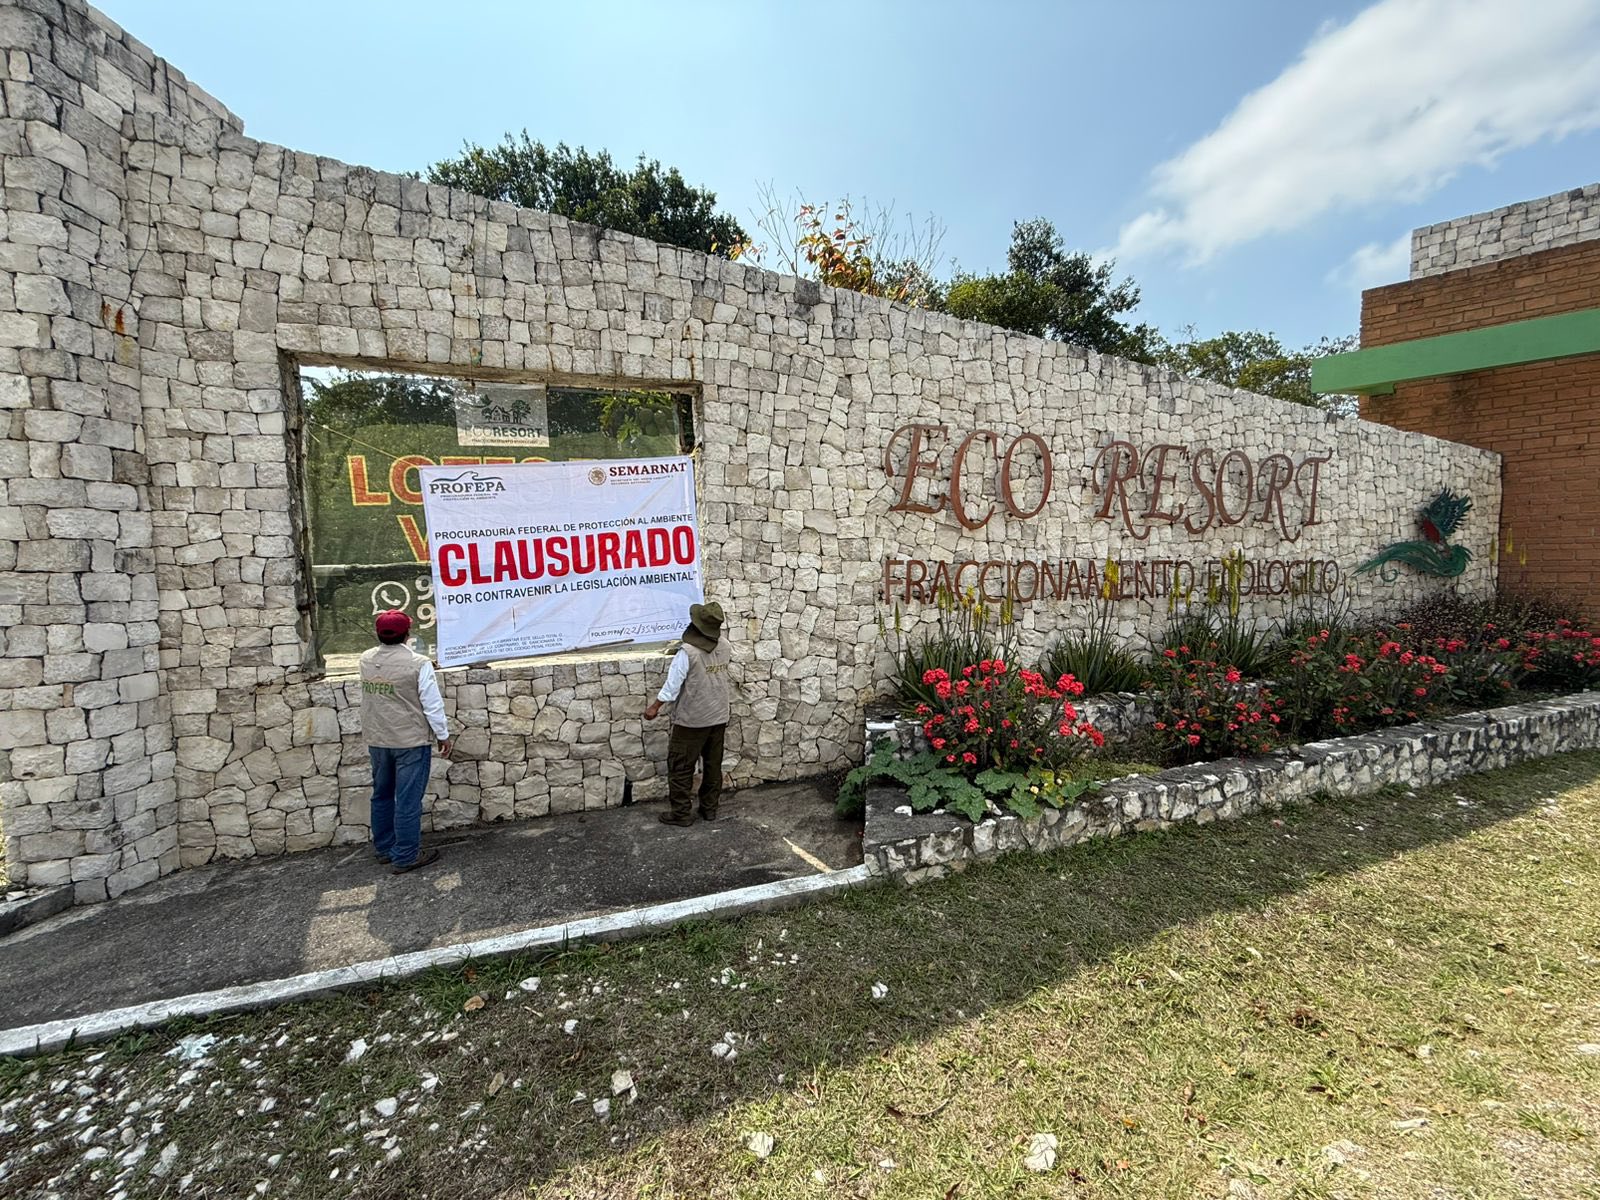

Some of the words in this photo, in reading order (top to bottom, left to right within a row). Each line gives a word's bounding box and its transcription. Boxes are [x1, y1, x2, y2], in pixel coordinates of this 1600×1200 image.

[609, 462, 687, 477] SEMARNAT
[884, 423, 1053, 531] ECO
[1092, 440, 1333, 543] RESORT
[429, 481, 506, 494] PROFEPA
[434, 526, 515, 540] PROCURADURÍA
[517, 524, 559, 535] FEDERAL
[563, 523, 577, 532] DE
[578, 517, 636, 531] PROTECCIÓN
[637, 517, 648, 525] AL
[650, 513, 693, 524] AMBIENTE
[437, 525, 696, 587] CLAUSURADO
[475, 584, 552, 603] CONTRAVENIR
[554, 583, 568, 593] LA
[570, 574, 637, 592] LEGISLACIÓN
